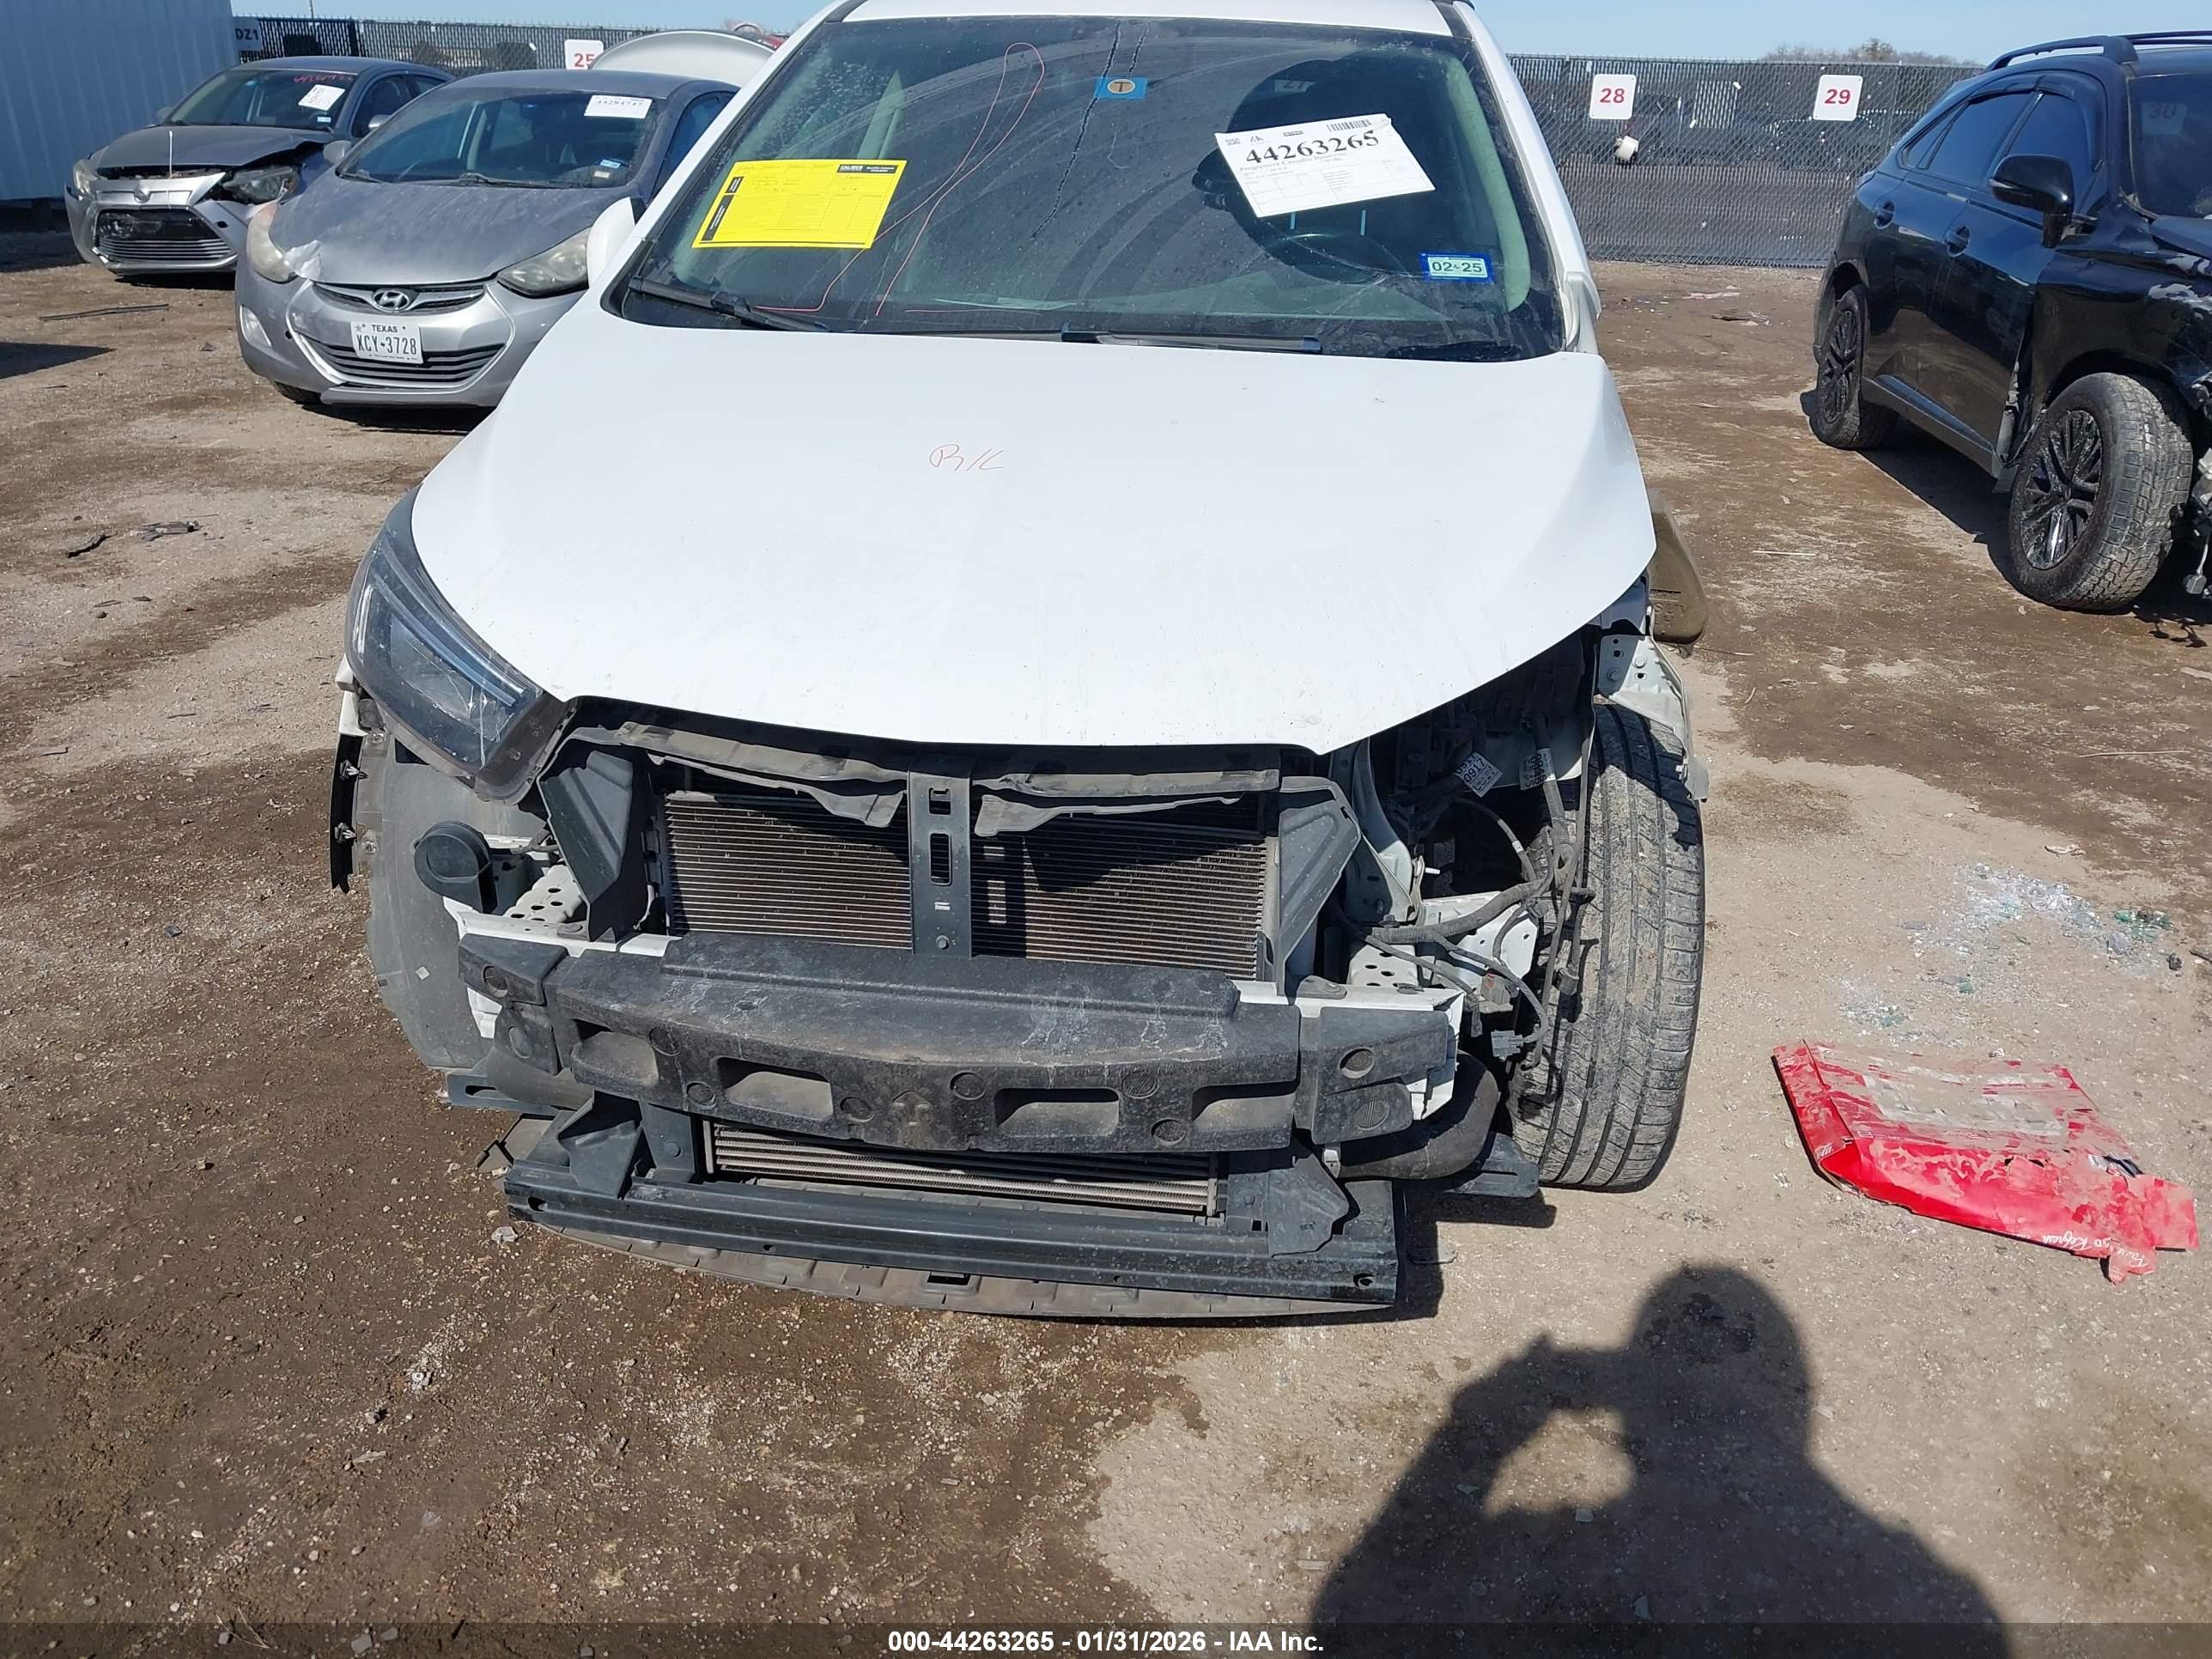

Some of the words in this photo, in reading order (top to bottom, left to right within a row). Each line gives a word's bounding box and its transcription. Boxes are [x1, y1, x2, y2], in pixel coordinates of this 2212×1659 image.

[574, 52, 596, 68] 25
[1600, 88, 1626, 104] 28
[1824, 88, 1851, 105] 29
[1246, 130, 1380, 164] 44263265
[371, 324, 398, 333] TEXAS
[1463, 757, 1486, 783] 0917
[2042, 1231, 2092, 1251] Refresh
